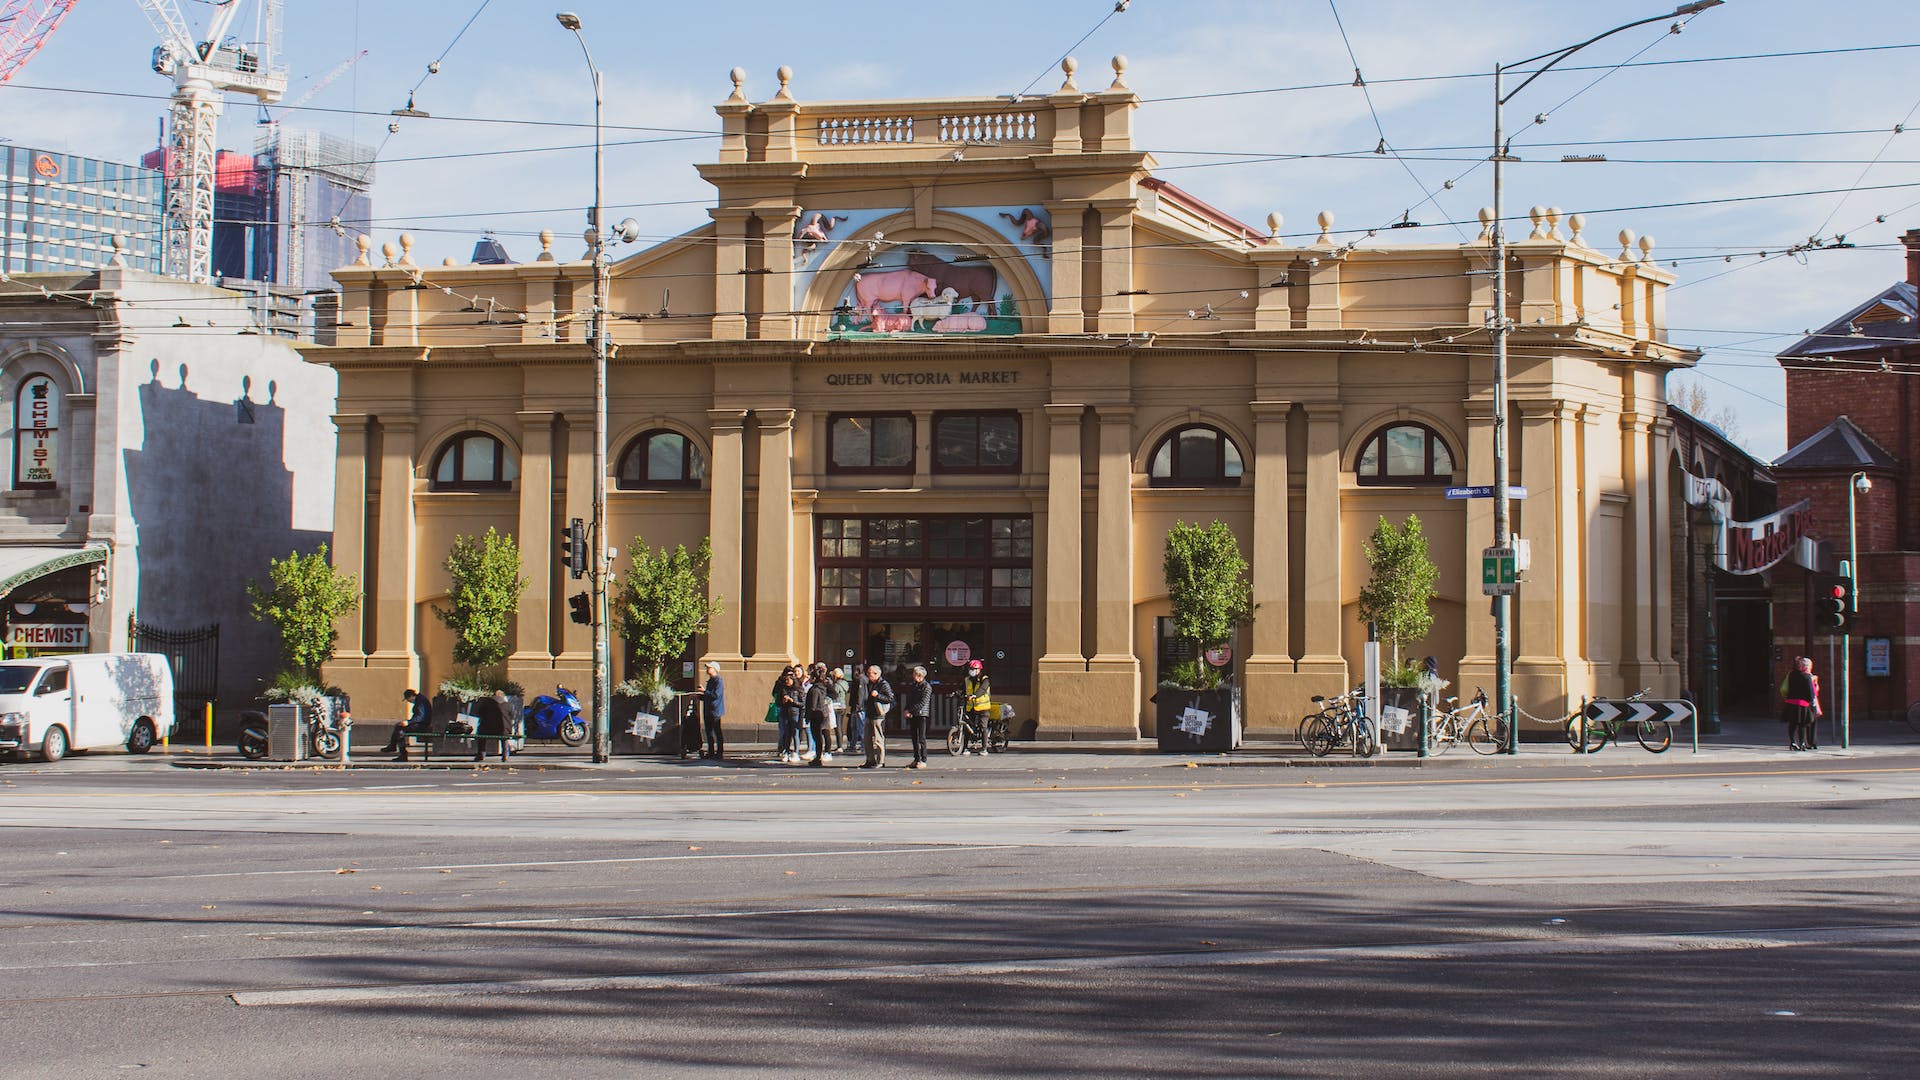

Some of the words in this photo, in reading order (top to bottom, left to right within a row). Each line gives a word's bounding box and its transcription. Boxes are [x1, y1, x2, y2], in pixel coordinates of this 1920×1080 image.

[826, 373, 872, 386] QUEEN
[881, 372, 951, 385] VICTORIA
[959, 371, 1020, 384] MARKET
[32, 401, 49, 466] CHEMIST
[1451, 488, 1481, 496] Elizabeth
[1482, 487, 1490, 495] St
[14, 627, 84, 643] CHEMIST
